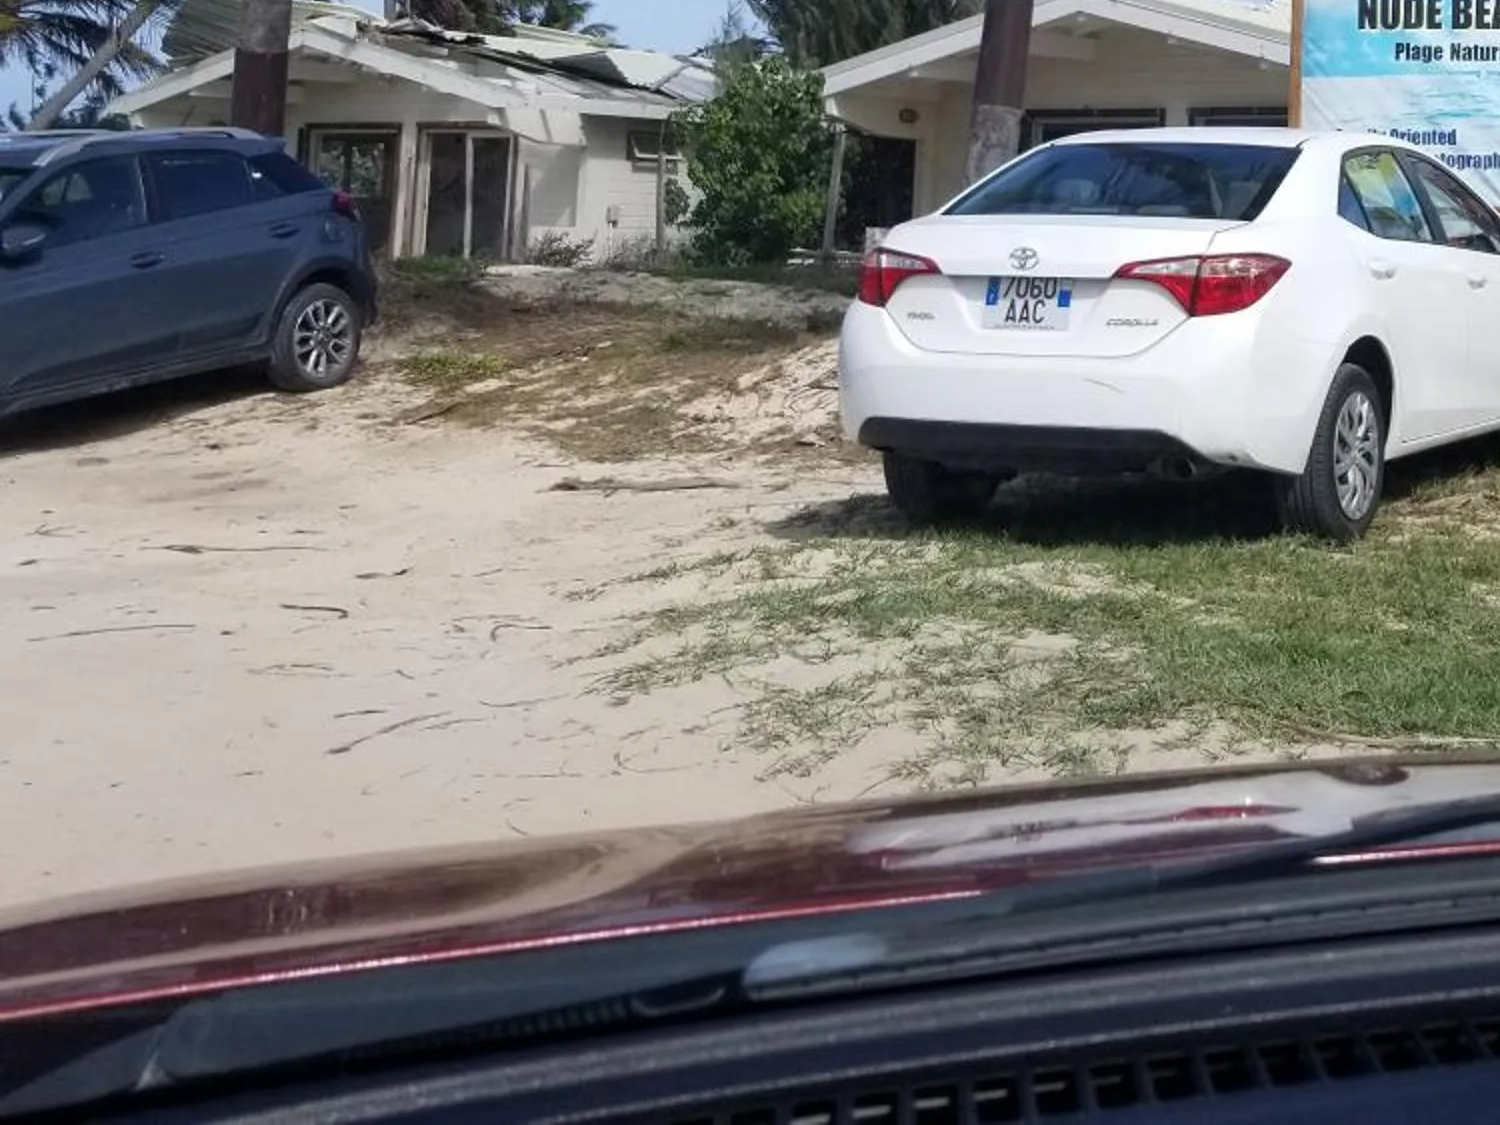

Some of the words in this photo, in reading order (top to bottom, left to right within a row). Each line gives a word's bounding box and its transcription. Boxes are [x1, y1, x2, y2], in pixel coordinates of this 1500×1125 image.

[1394, 41, 1444, 64] Plage
[1003, 276, 1059, 300] 7060
[1004, 298, 1046, 324] AAC
